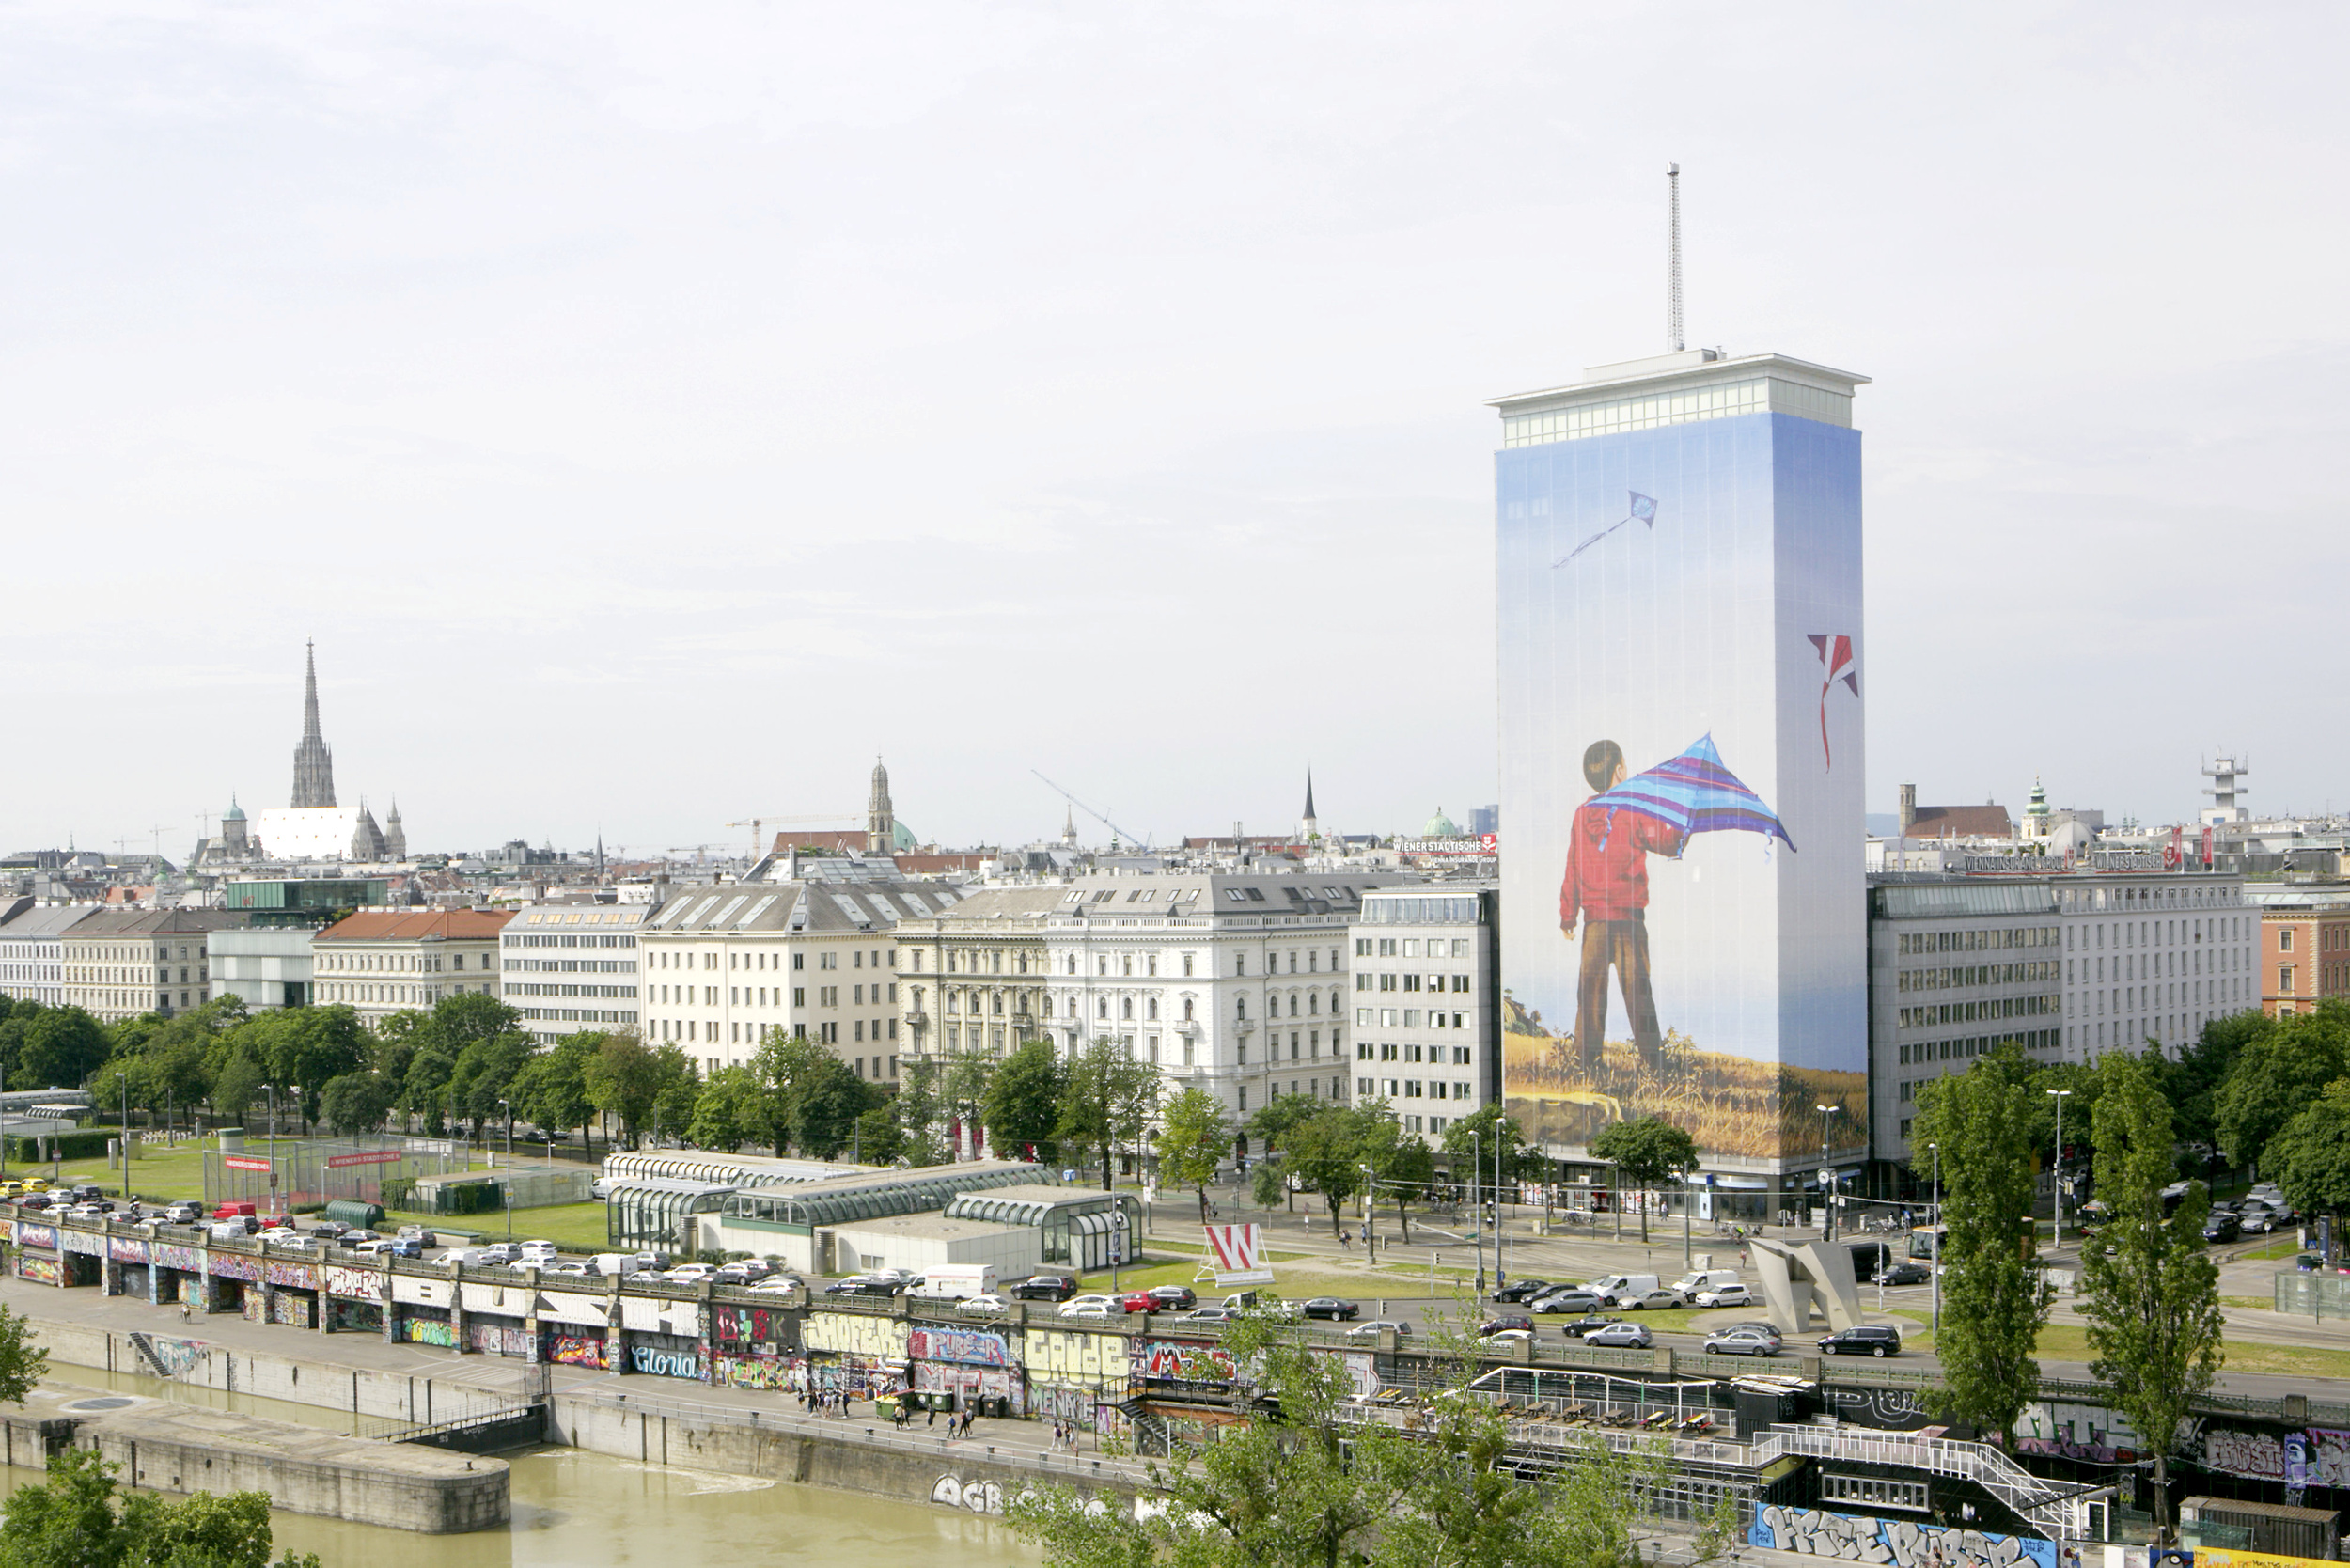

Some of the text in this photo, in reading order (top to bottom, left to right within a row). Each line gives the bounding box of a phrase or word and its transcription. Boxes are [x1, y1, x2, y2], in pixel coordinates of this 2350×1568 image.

[1393, 840, 1481, 852] WIENER STÄDTISCHE
[1966, 856, 1994, 870] VIENNA
